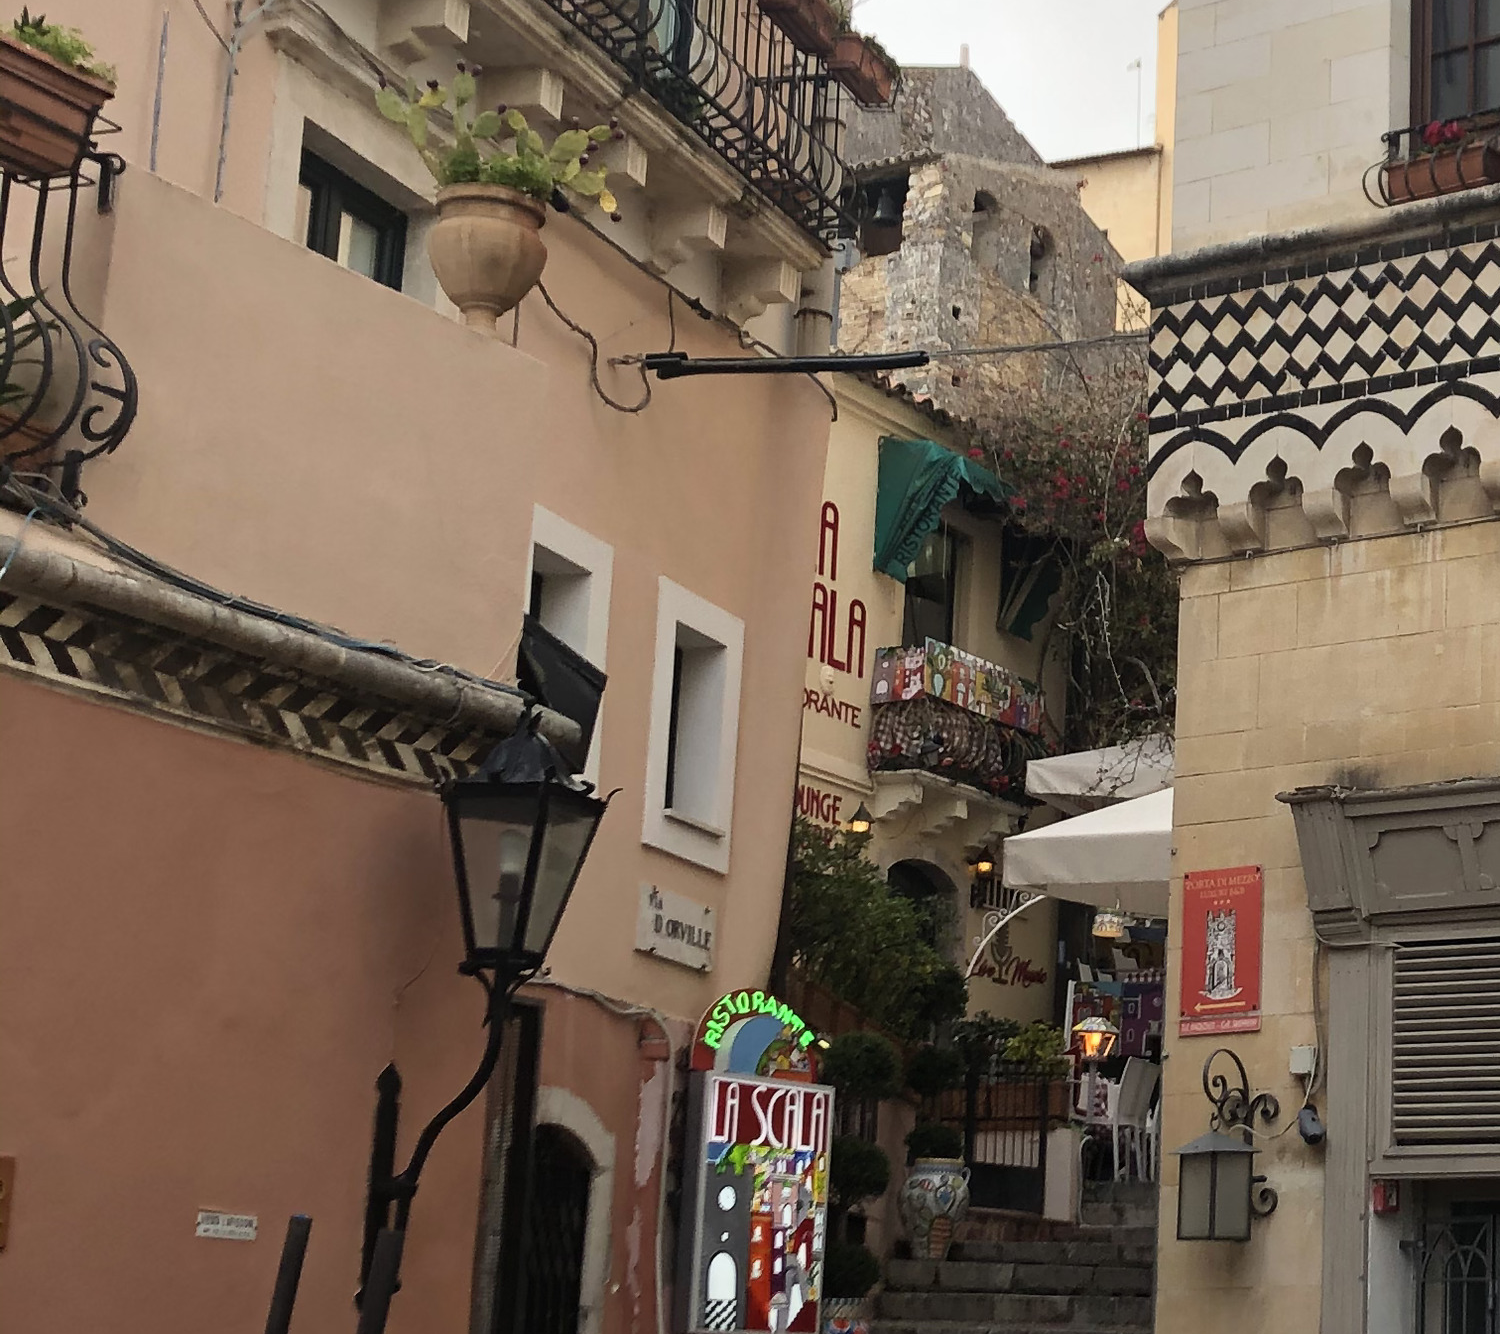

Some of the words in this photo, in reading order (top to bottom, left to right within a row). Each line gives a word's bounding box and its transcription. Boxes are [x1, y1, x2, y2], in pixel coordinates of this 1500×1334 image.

[703, 990, 815, 1051] RISTORANTE
[711, 1081, 740, 1143] LA
[750, 1085, 826, 1152] SCALA
